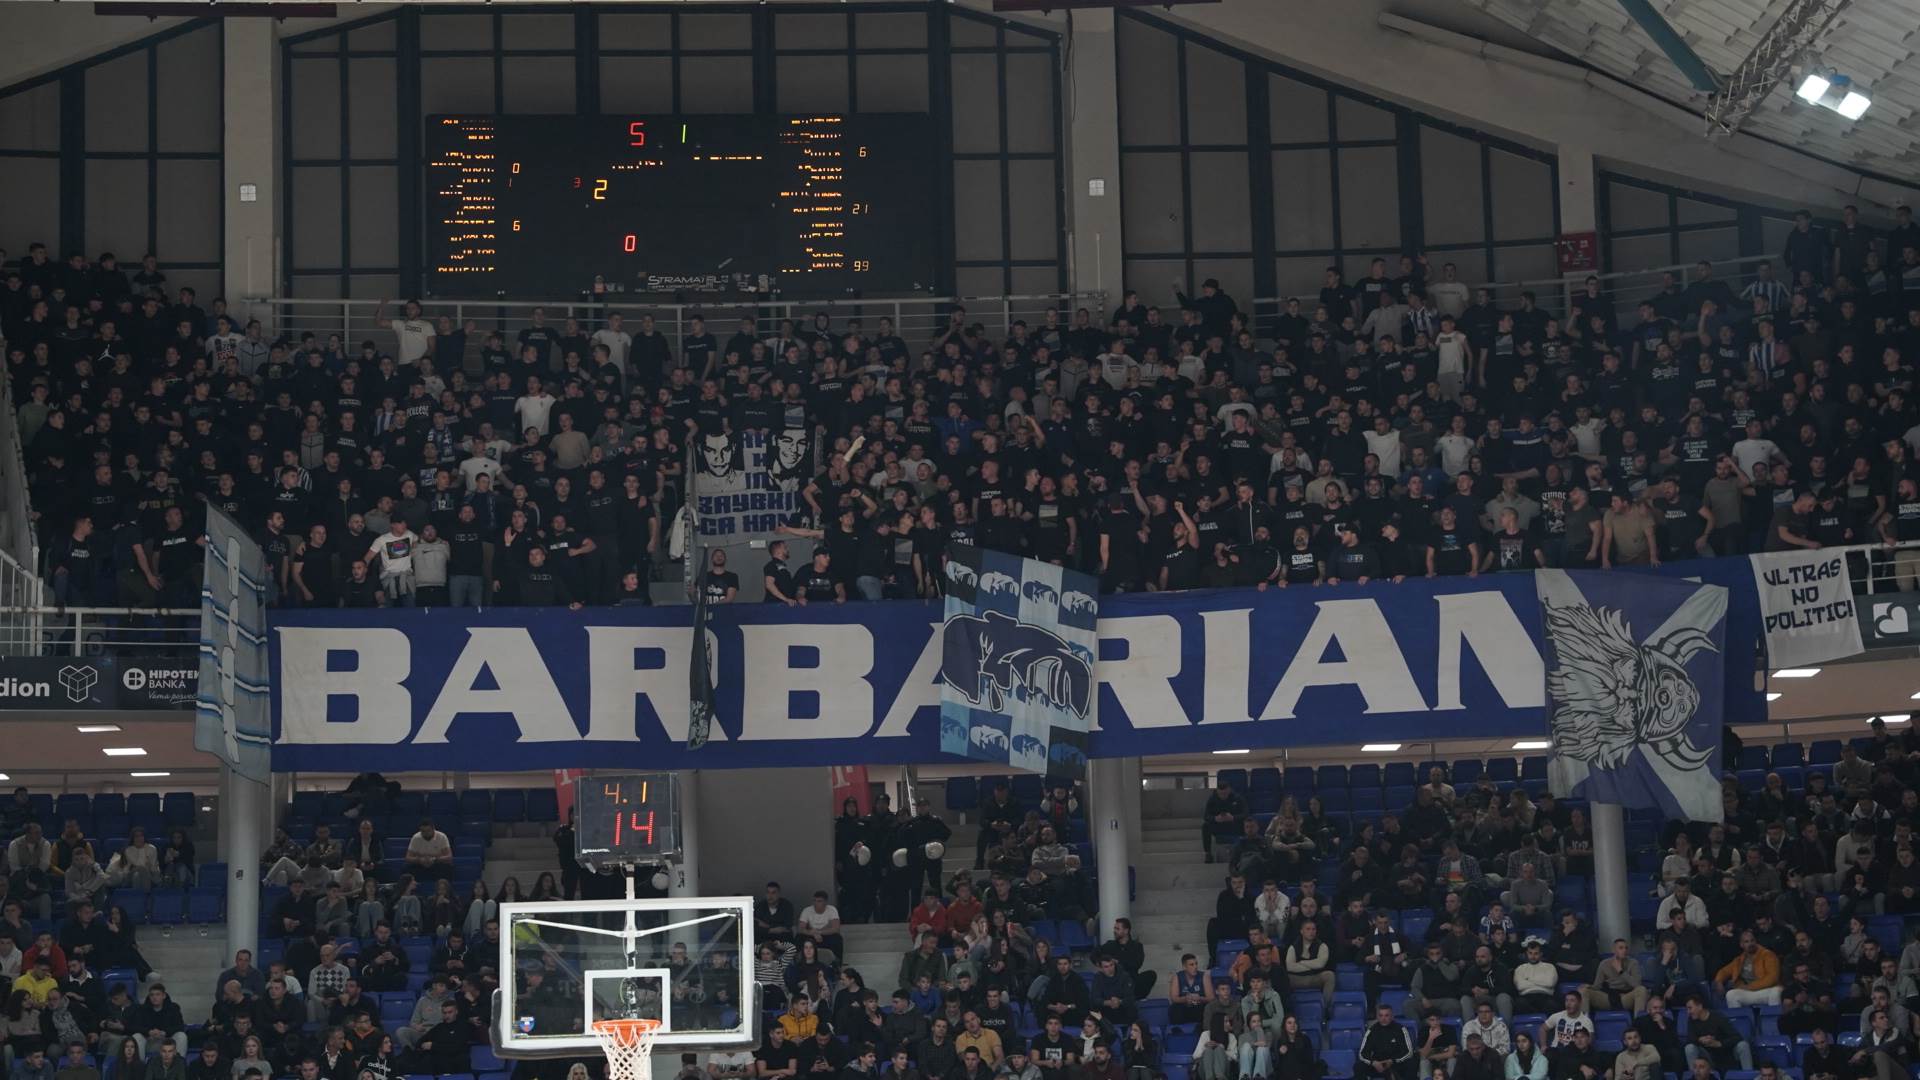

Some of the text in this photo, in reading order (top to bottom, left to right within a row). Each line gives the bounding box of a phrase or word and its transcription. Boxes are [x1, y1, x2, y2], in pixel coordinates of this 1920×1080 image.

[859, 146, 867, 157] 6
[512, 163, 520, 173] 0
[594, 179, 608, 199] 2
[852, 203, 868, 214] 21
[513, 220, 520, 231] 6
[624, 235, 636, 252] 0
[854, 260, 869, 272] 99
[1763, 558, 1841, 586] ULTRAS
[1791, 586, 1819, 606] NO
[149, 679, 186, 689] BANKA
[615, 810, 653, 846] 14
